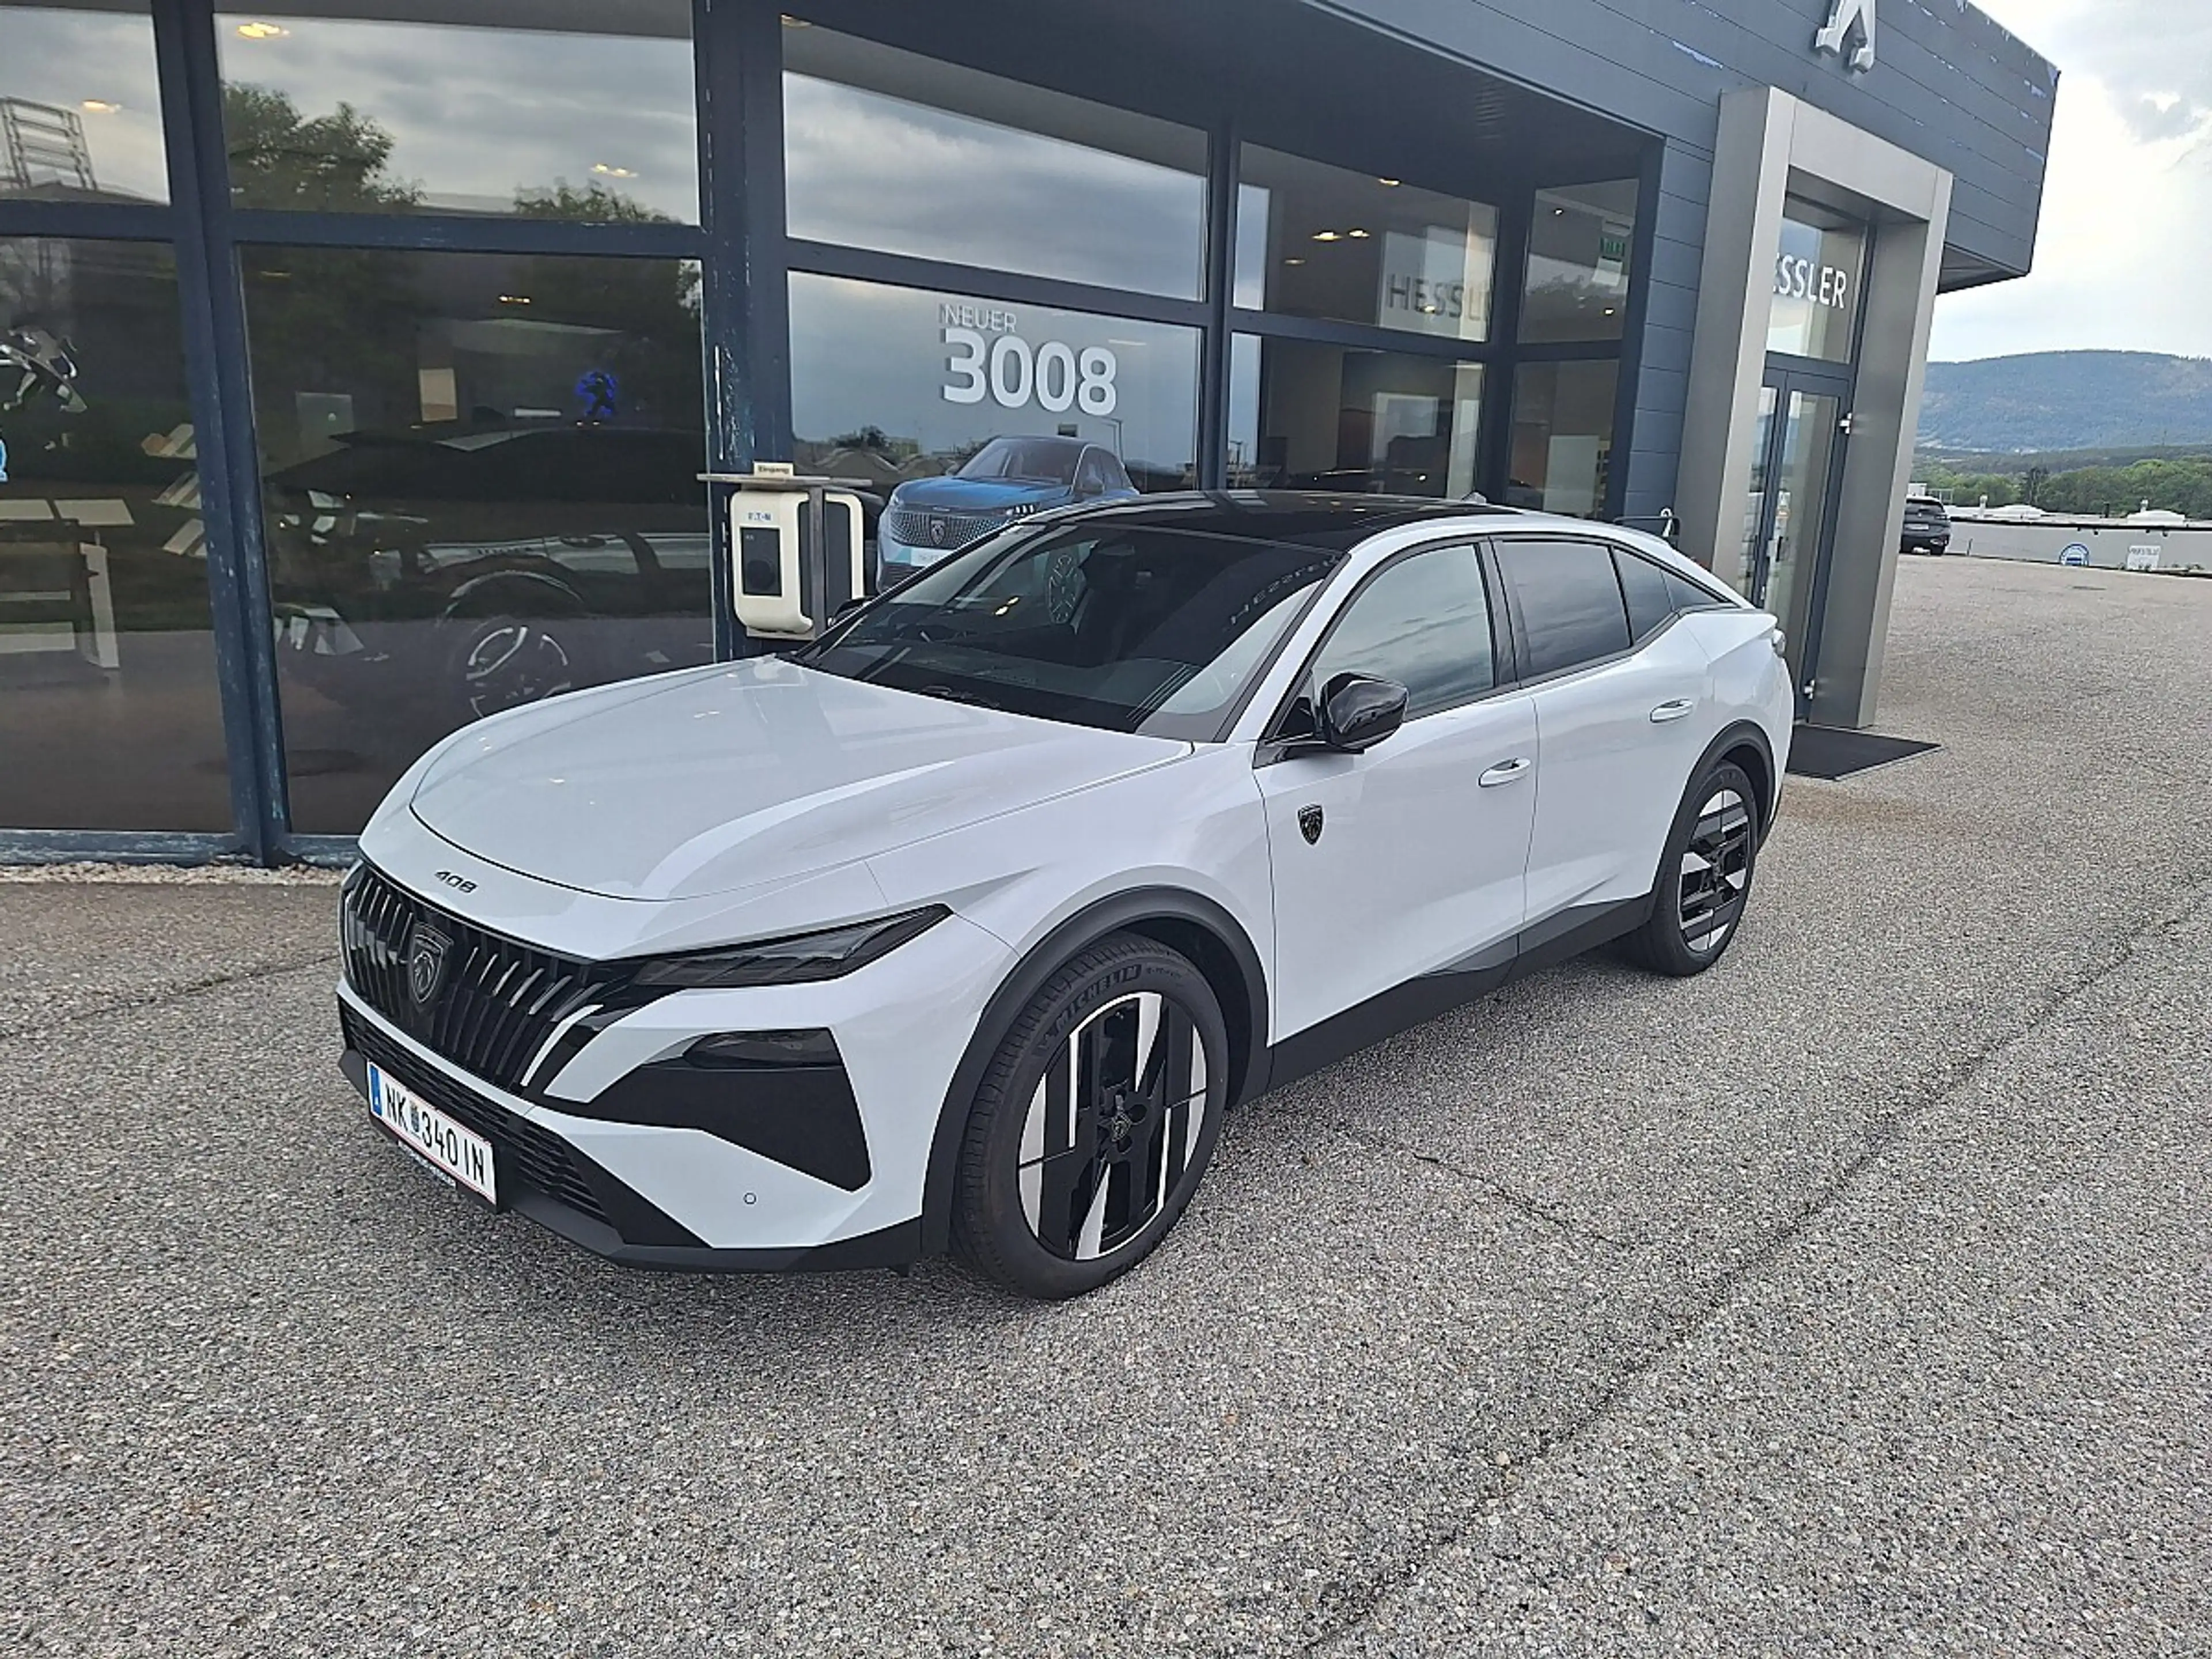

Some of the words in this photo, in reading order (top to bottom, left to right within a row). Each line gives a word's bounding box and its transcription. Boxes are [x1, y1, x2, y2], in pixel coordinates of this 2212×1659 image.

[1773, 252, 1847, 309] SSLER
[942, 304, 1017, 332] NEUER
[943, 328, 1117, 416] 3008
[434, 872, 478, 893] 408
[1055, 964, 1142, 1032] MICHELIN
[385, 1083, 408, 1132] NK
[422, 1111, 458, 1166] 340
[464, 1139, 484, 1184] IN
